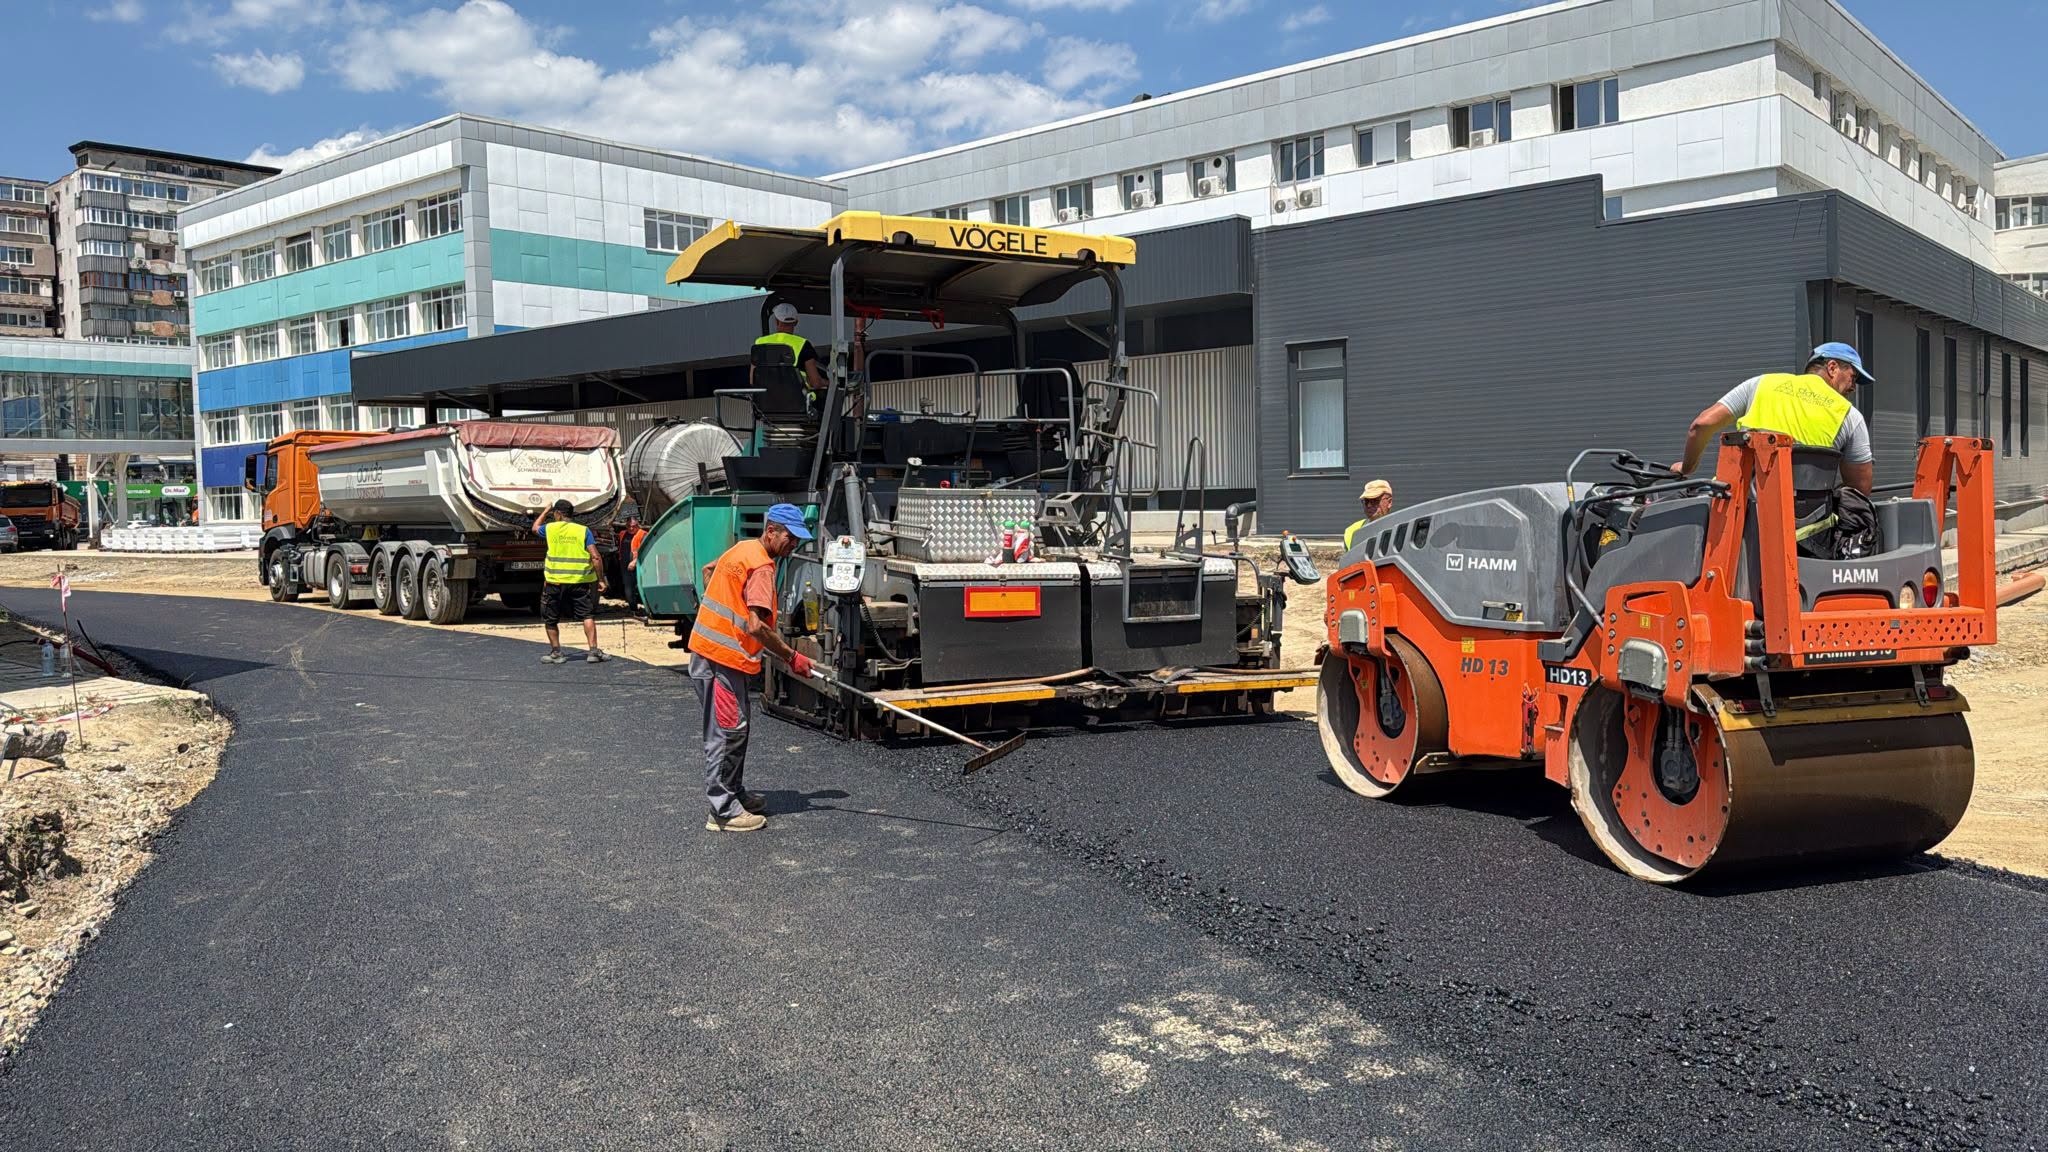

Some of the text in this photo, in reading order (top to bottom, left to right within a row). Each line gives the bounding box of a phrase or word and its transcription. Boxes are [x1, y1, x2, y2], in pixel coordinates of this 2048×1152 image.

[949, 224, 1047, 255] VÖGELE
[1798, 387, 1835, 404] davide
[1467, 556, 1517, 572] HAMM
[1832, 568, 1879, 584] HAMM
[1460, 657, 1509, 676] HD 13
[1549, 667, 1588, 686] HD13
